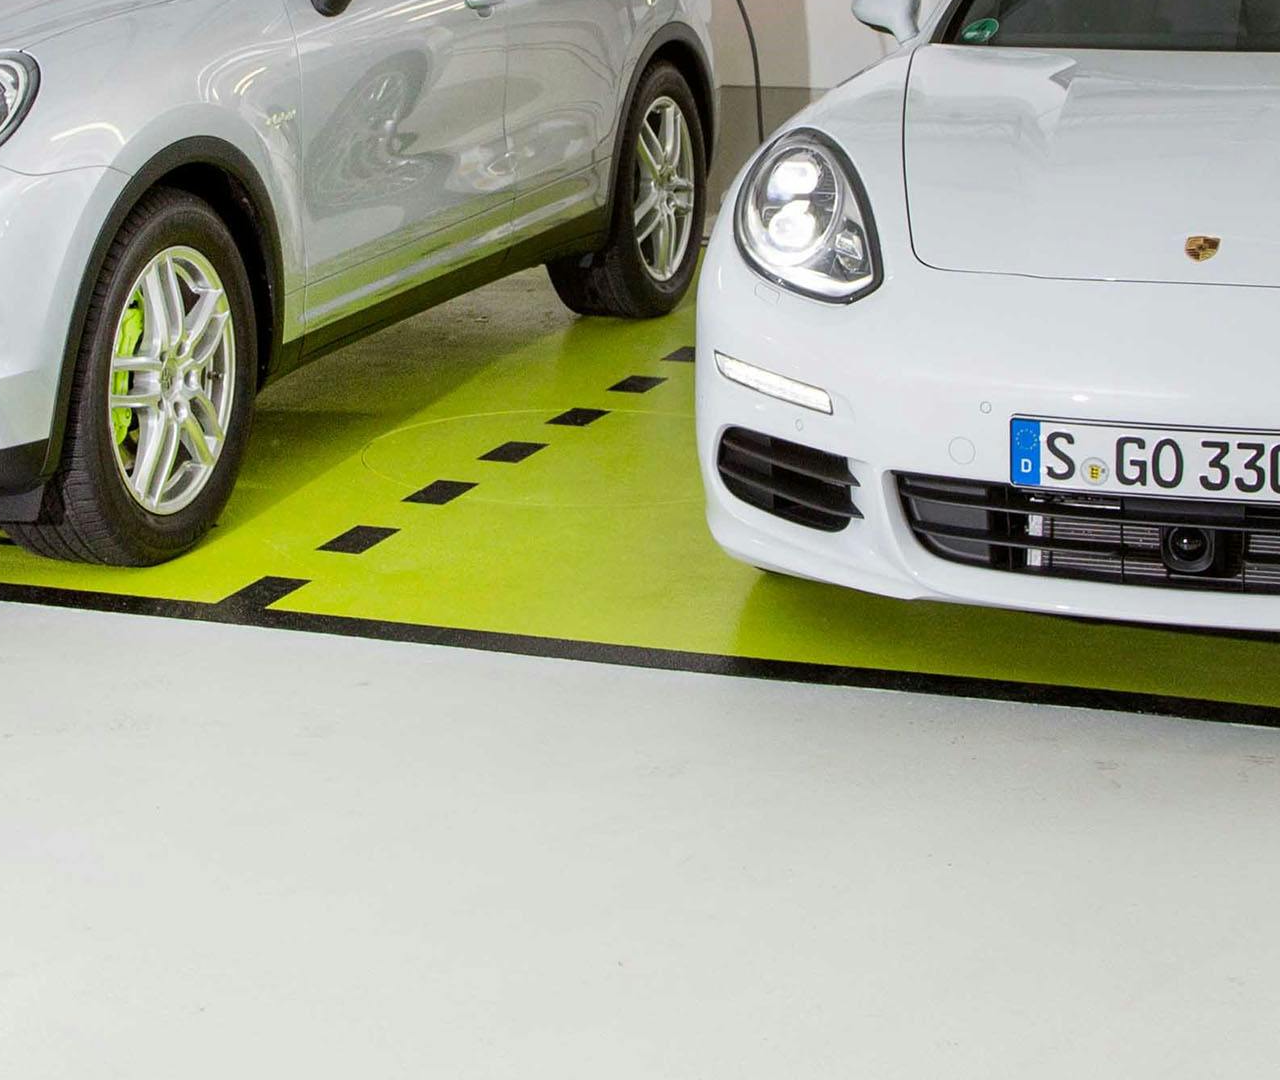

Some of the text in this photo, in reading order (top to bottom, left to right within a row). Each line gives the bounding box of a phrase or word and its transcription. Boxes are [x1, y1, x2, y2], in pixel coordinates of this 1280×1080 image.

[1021, 458, 1032, 473] D
[1045, 431, 1076, 481] S
[1115, 436, 1184, 490] GO
